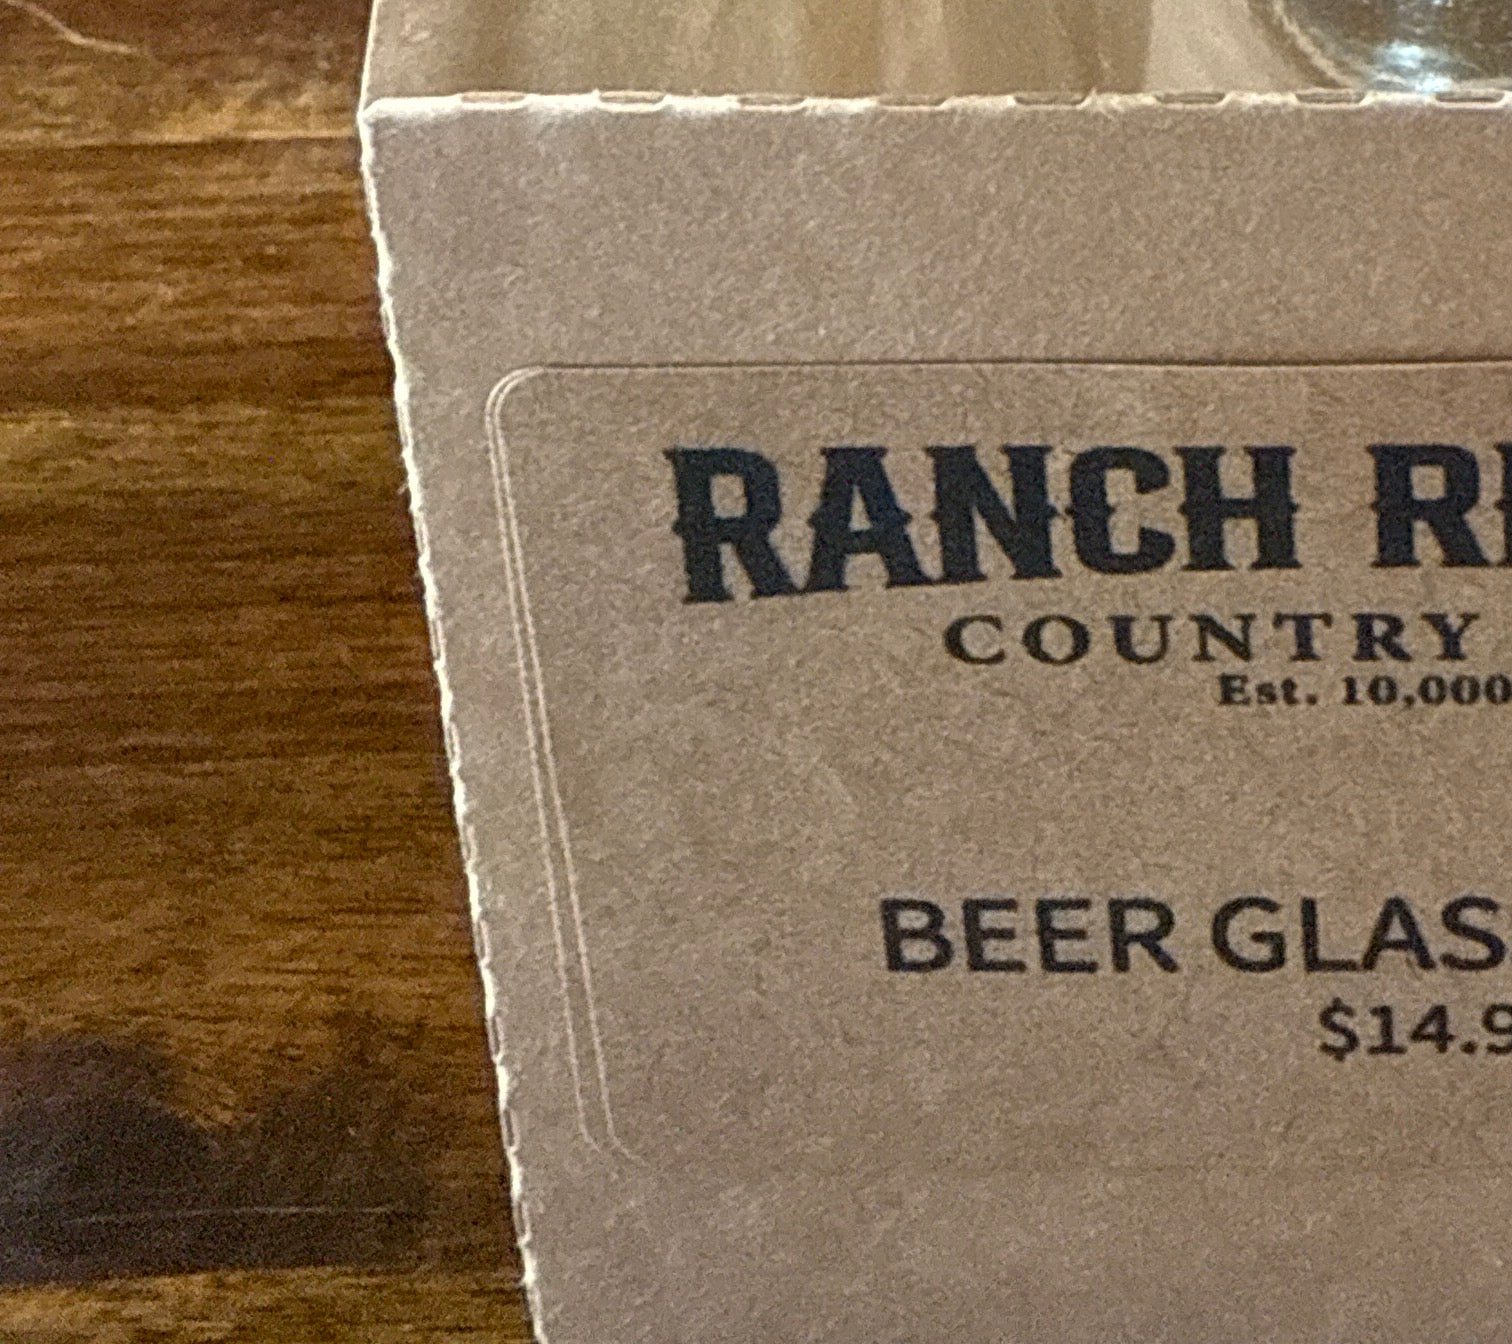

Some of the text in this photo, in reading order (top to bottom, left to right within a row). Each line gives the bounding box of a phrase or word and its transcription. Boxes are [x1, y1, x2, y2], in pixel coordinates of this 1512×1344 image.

[664, 444, 1302, 605] RANCH
[943, 612, 1480, 666] COUNTRY
[1217, 672, 1319, 708] Est.
[881, 895, 1180, 974] BEER
